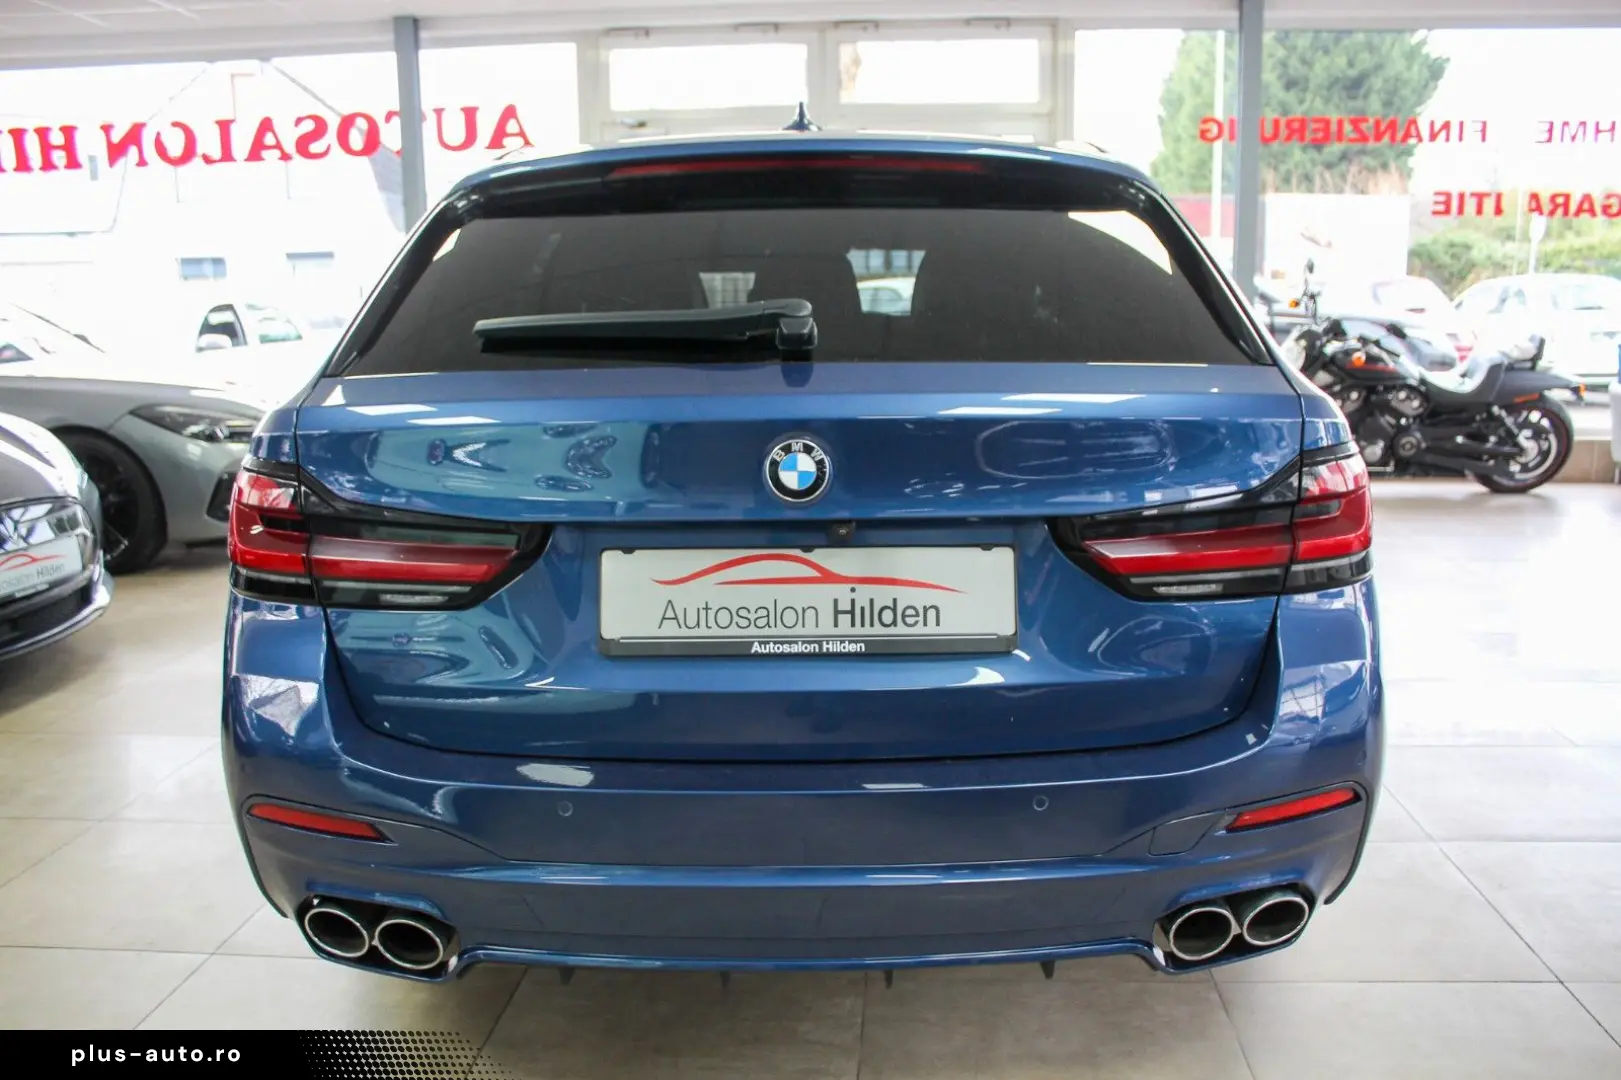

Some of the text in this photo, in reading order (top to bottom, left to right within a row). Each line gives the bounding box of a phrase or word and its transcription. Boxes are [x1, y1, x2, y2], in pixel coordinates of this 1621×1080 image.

[773, 442, 824, 462] BMW
[658, 587, 941, 629] Autosalon Hilden
[751, 640, 865, 653] Autosalon Hilden
